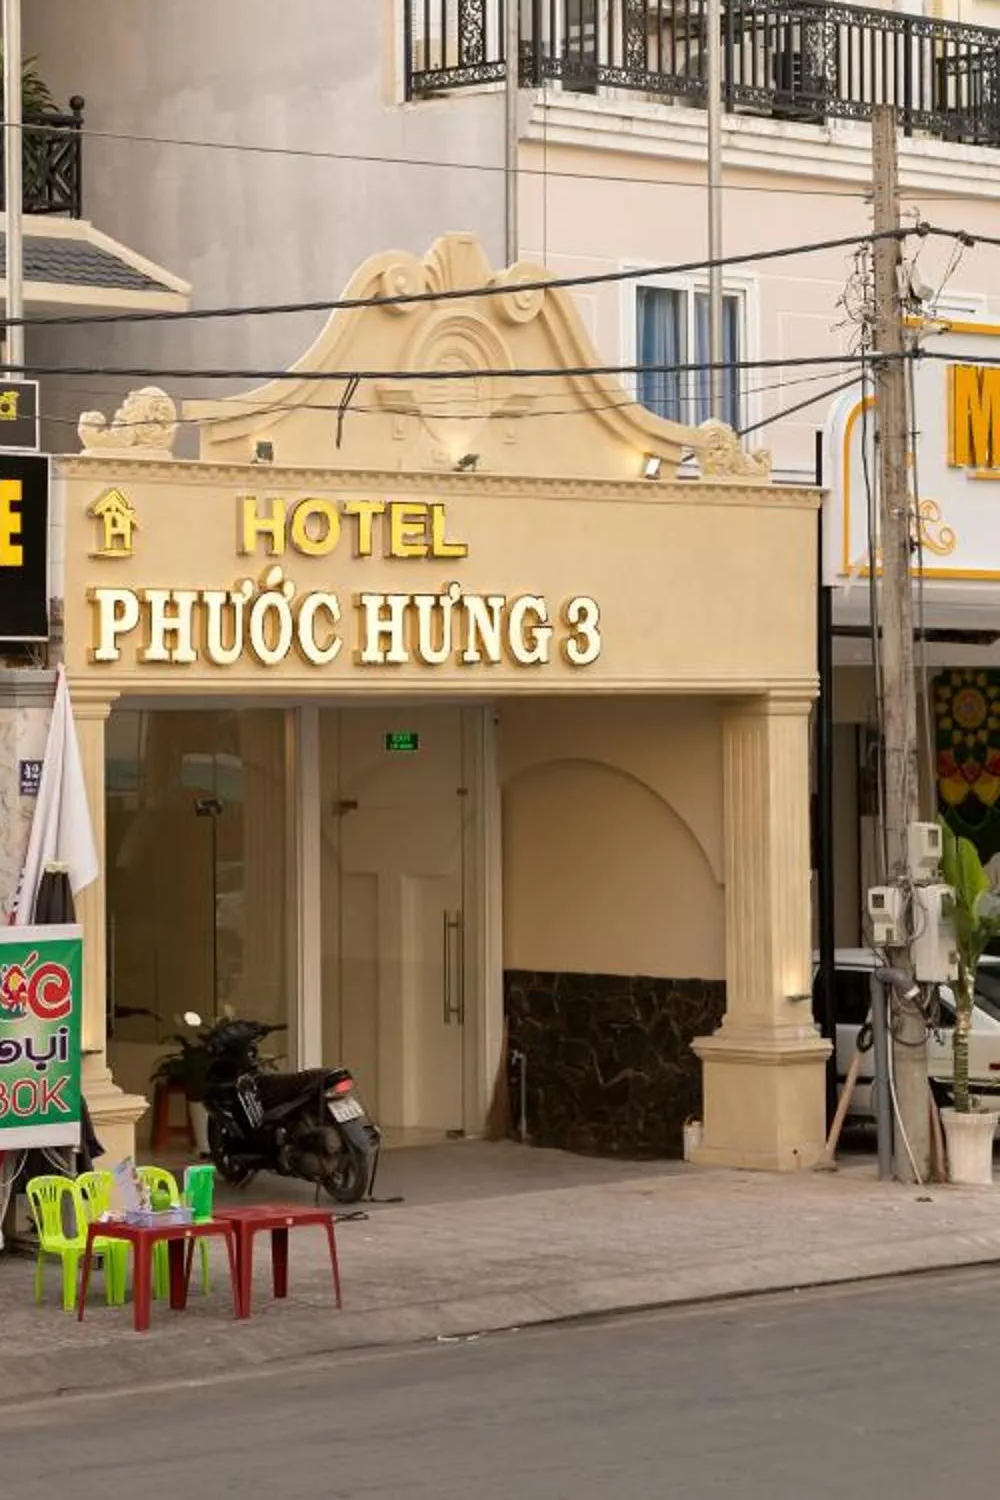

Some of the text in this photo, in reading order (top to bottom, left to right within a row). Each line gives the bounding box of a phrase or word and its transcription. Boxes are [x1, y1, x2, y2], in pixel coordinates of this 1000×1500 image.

[238, 495, 469, 560] HOTEL
[90, 563, 602, 667] PHƯỚC HƯNG 3
